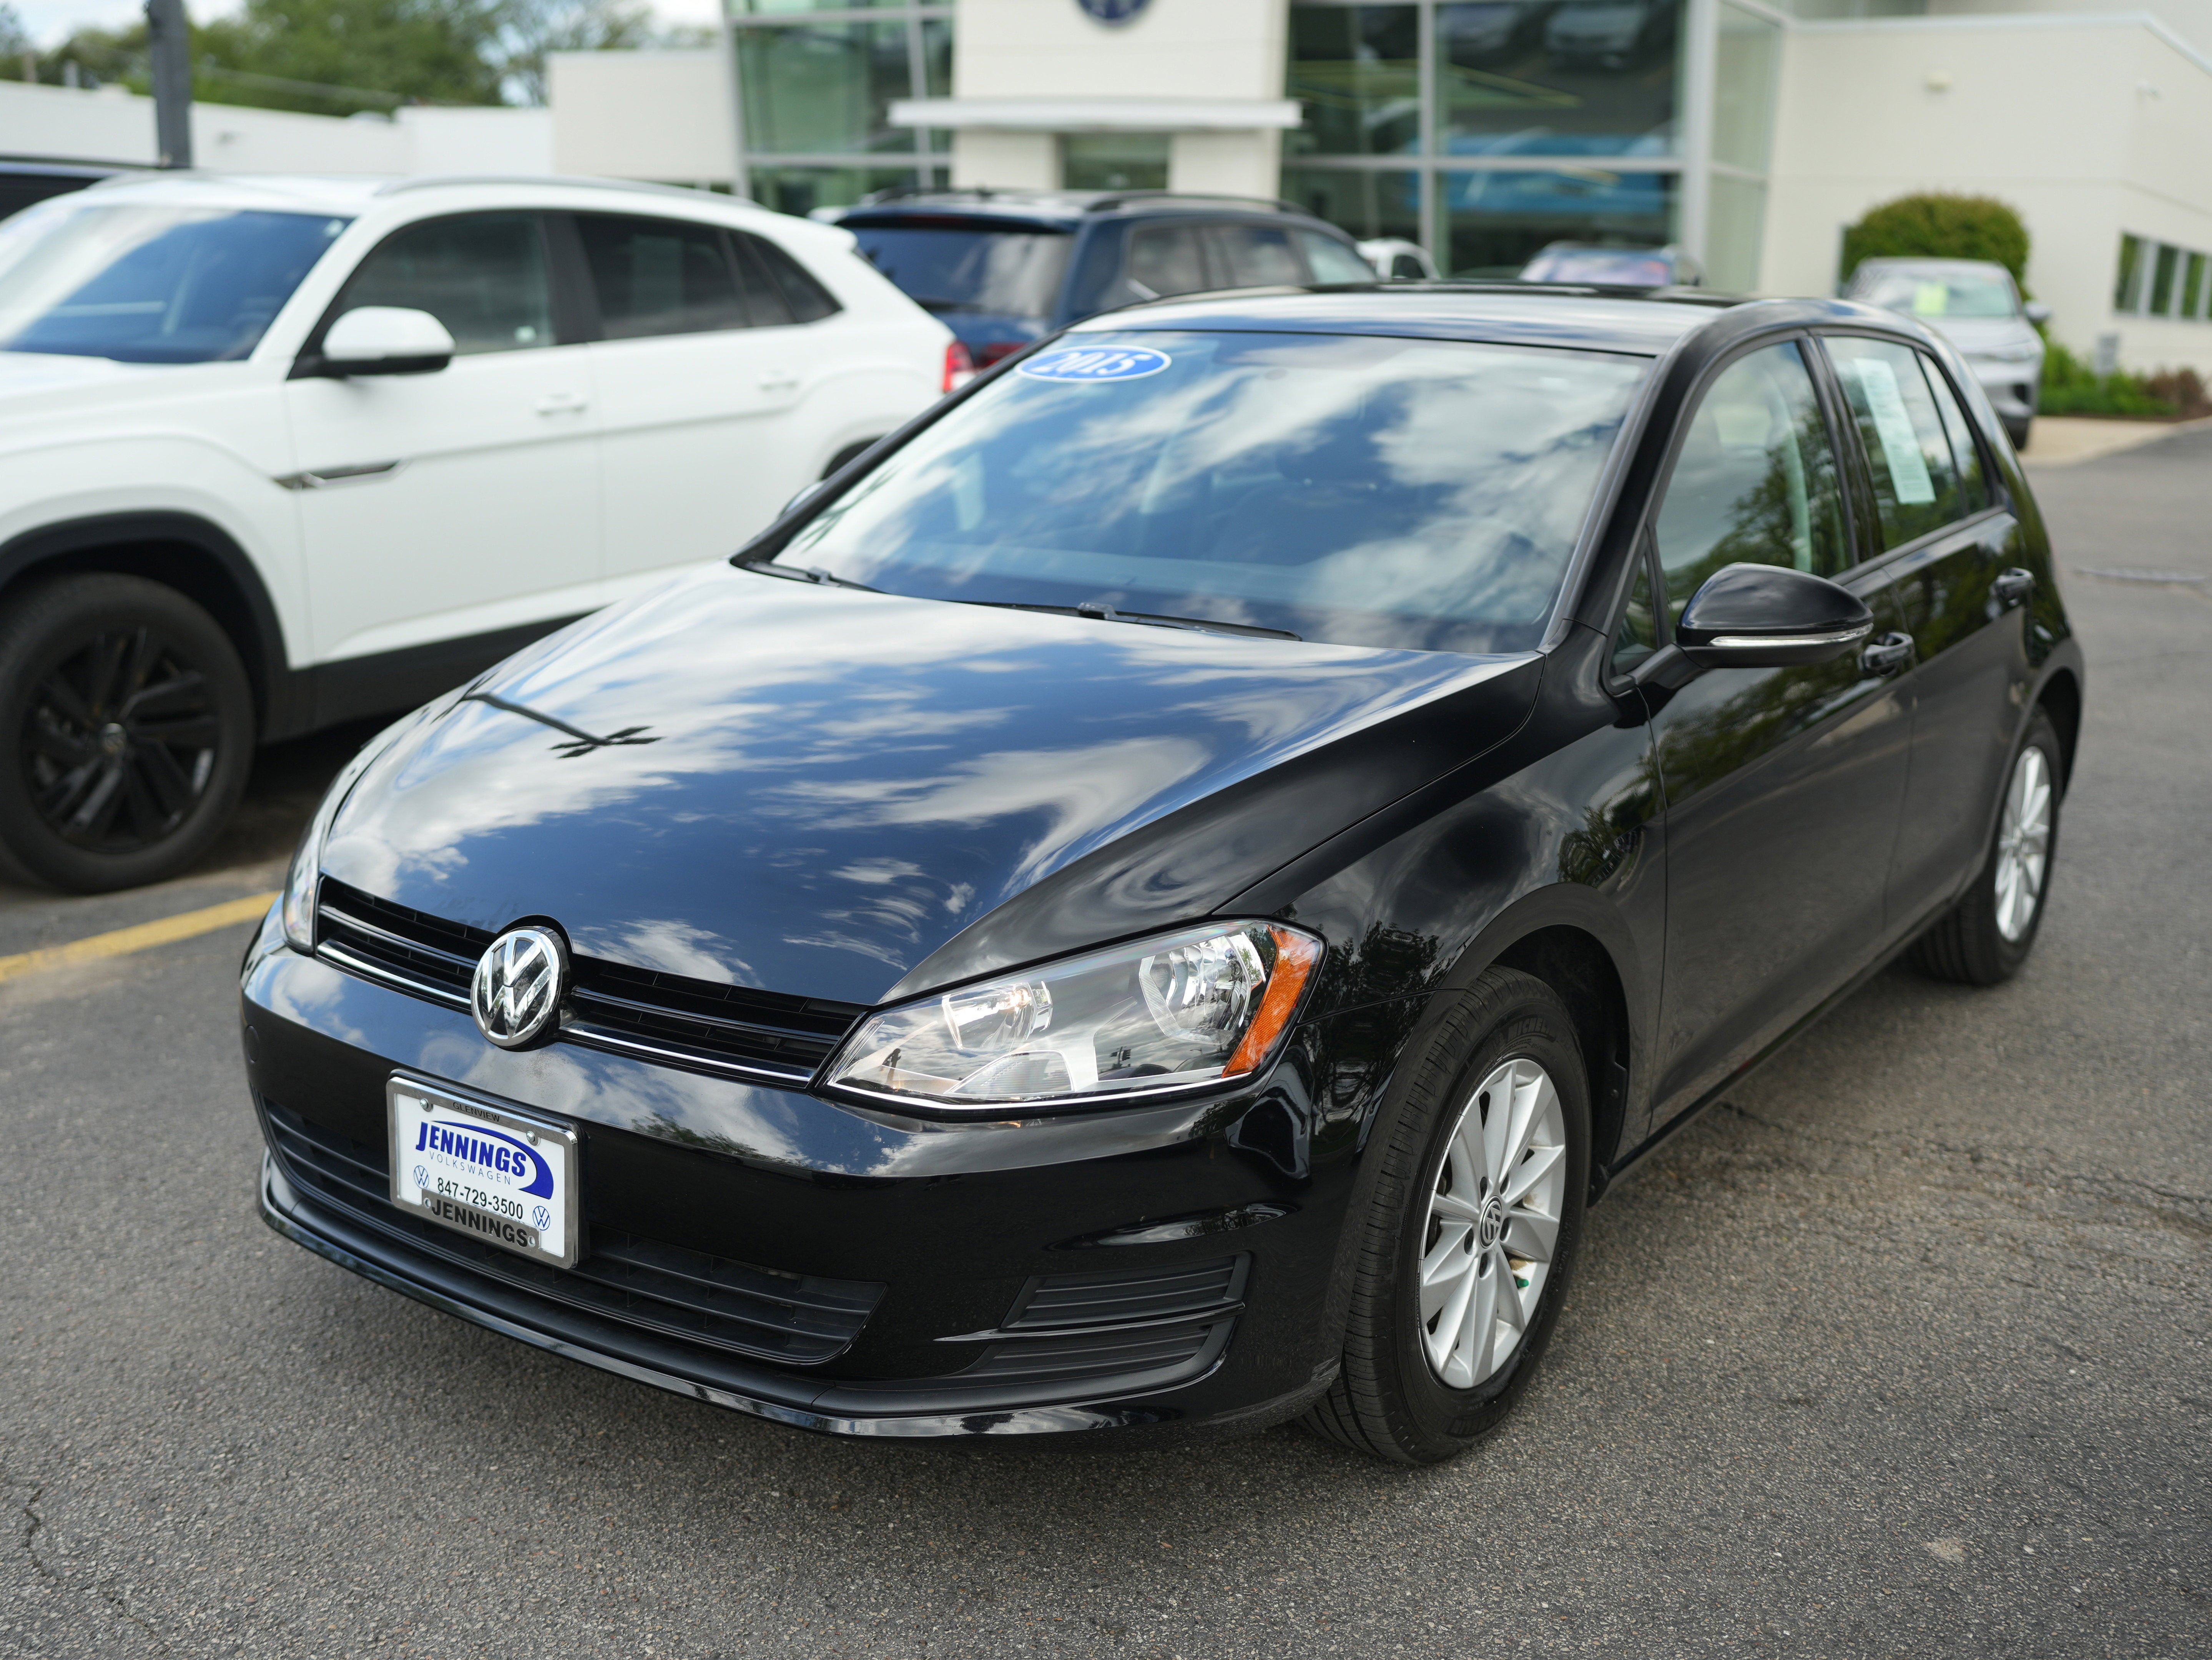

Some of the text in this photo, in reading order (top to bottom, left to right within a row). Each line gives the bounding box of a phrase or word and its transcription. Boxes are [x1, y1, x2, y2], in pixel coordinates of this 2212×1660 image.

[1031, 351, 1153, 376] 2015
[453, 1102, 500, 1122] GLENVIEW
[415, 1121, 526, 1177] JENNINGS
[429, 1150, 510, 1185] VOLKSWAGEN
[437, 1177, 523, 1219] 847-729-3500
[432, 1199, 528, 1247] JENNINGS
